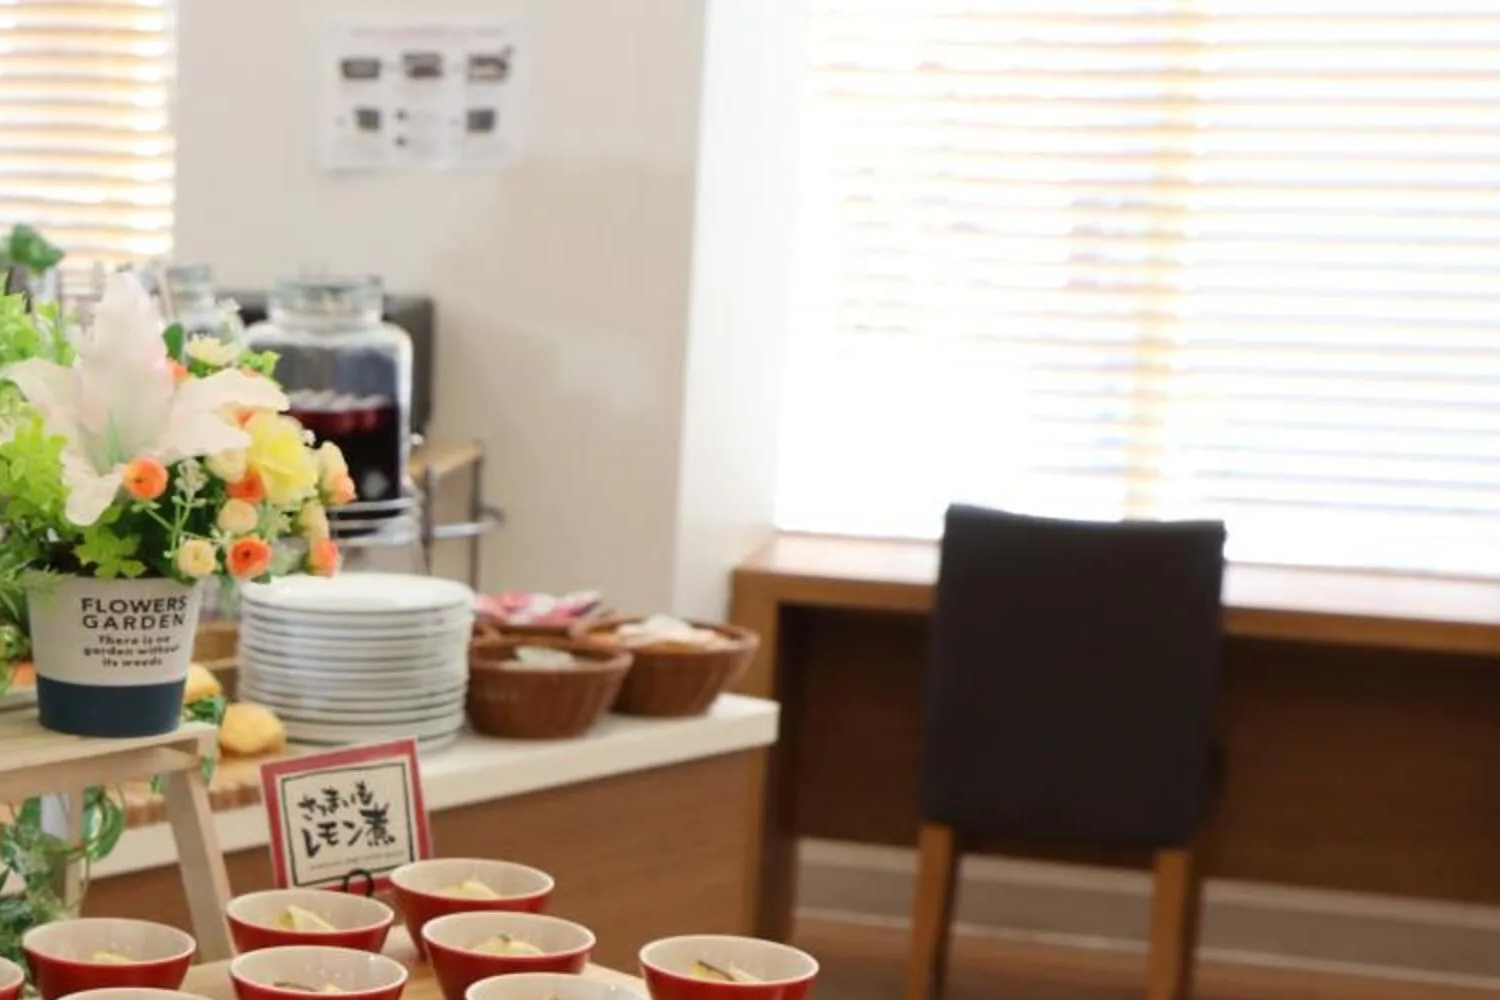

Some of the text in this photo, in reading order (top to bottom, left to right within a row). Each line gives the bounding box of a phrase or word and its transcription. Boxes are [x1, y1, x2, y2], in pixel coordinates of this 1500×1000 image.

[82, 595, 187, 614] FLOWERS
[82, 613, 184, 630] GARDEN
[301, 802, 396, 859] レモン煮
